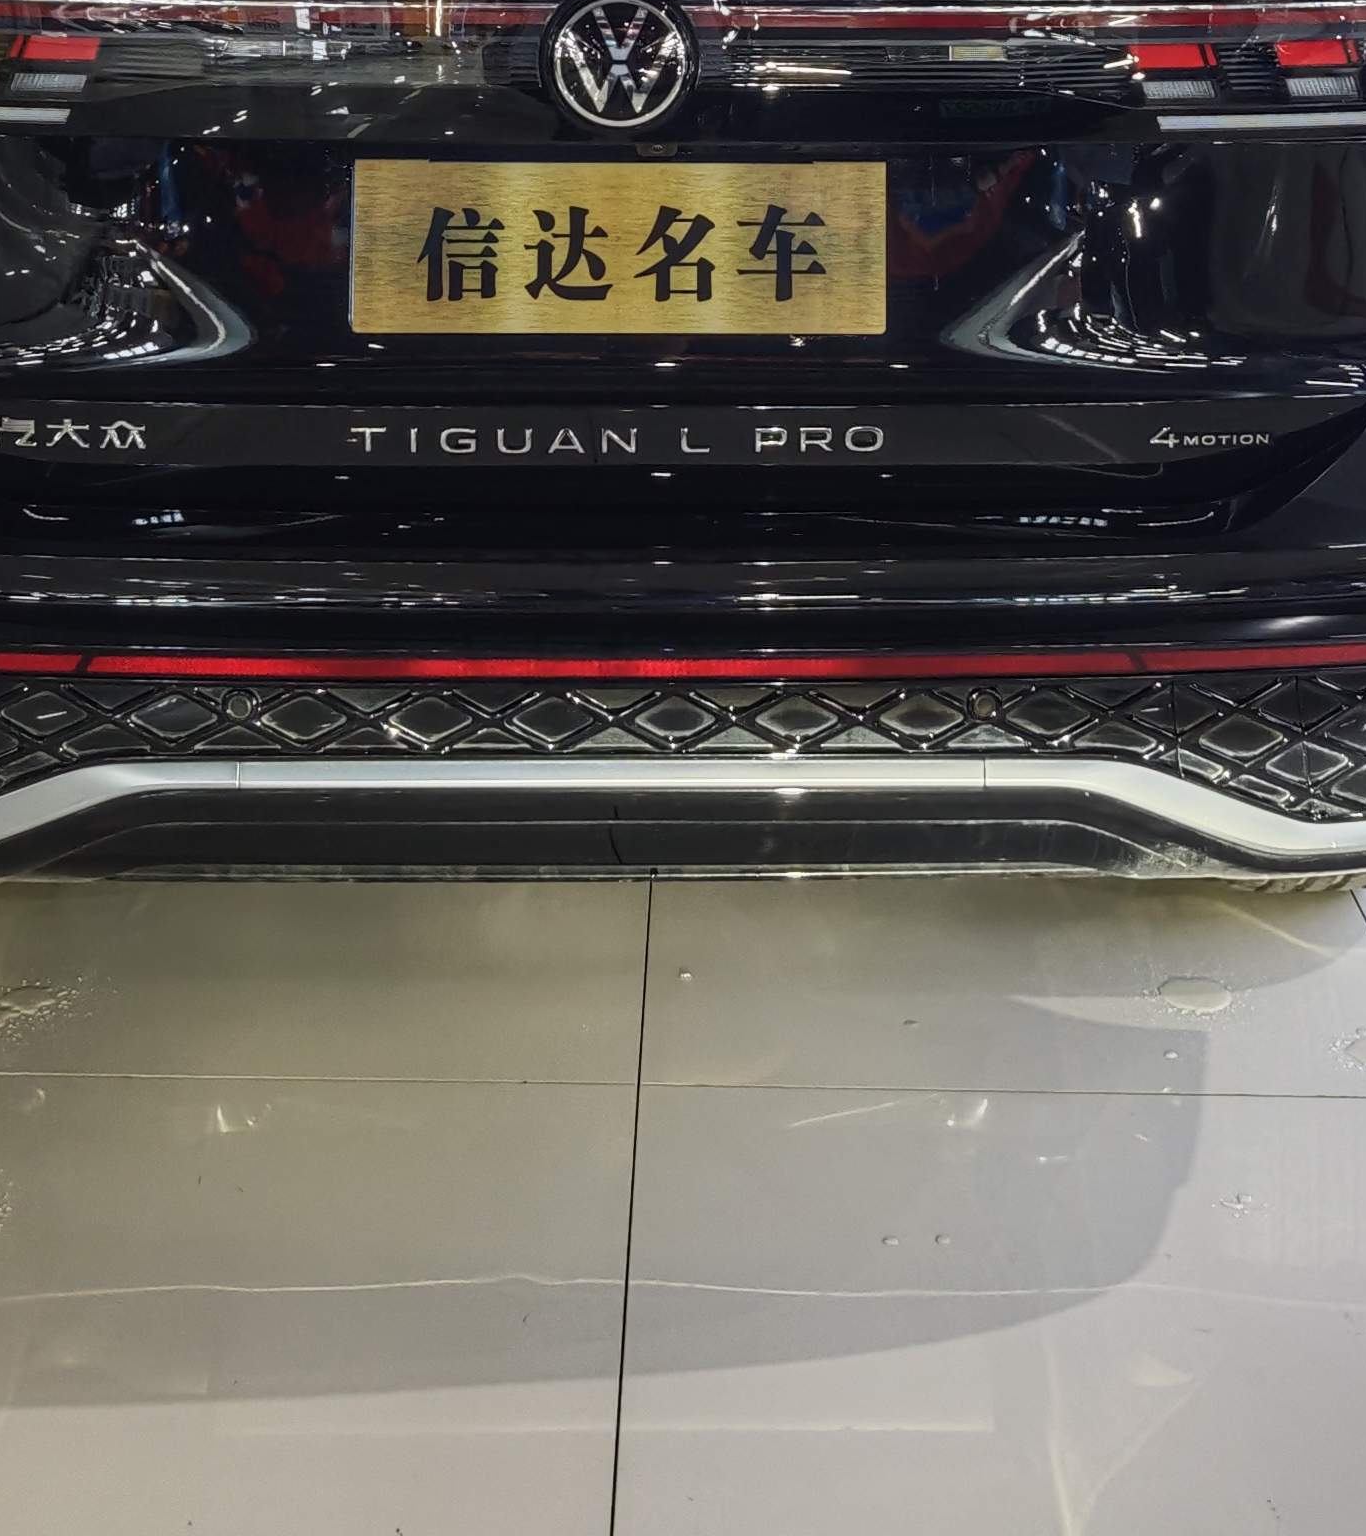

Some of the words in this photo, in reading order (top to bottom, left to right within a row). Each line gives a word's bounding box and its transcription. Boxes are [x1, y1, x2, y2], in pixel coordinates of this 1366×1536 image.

[416, 205, 828, 303] 信达名车
[350, 426, 638, 455] TIGUAN
[681, 427, 710, 454] L
[754, 426, 885, 454] PRO
[1149, 426, 1271, 449] 4MOTION
